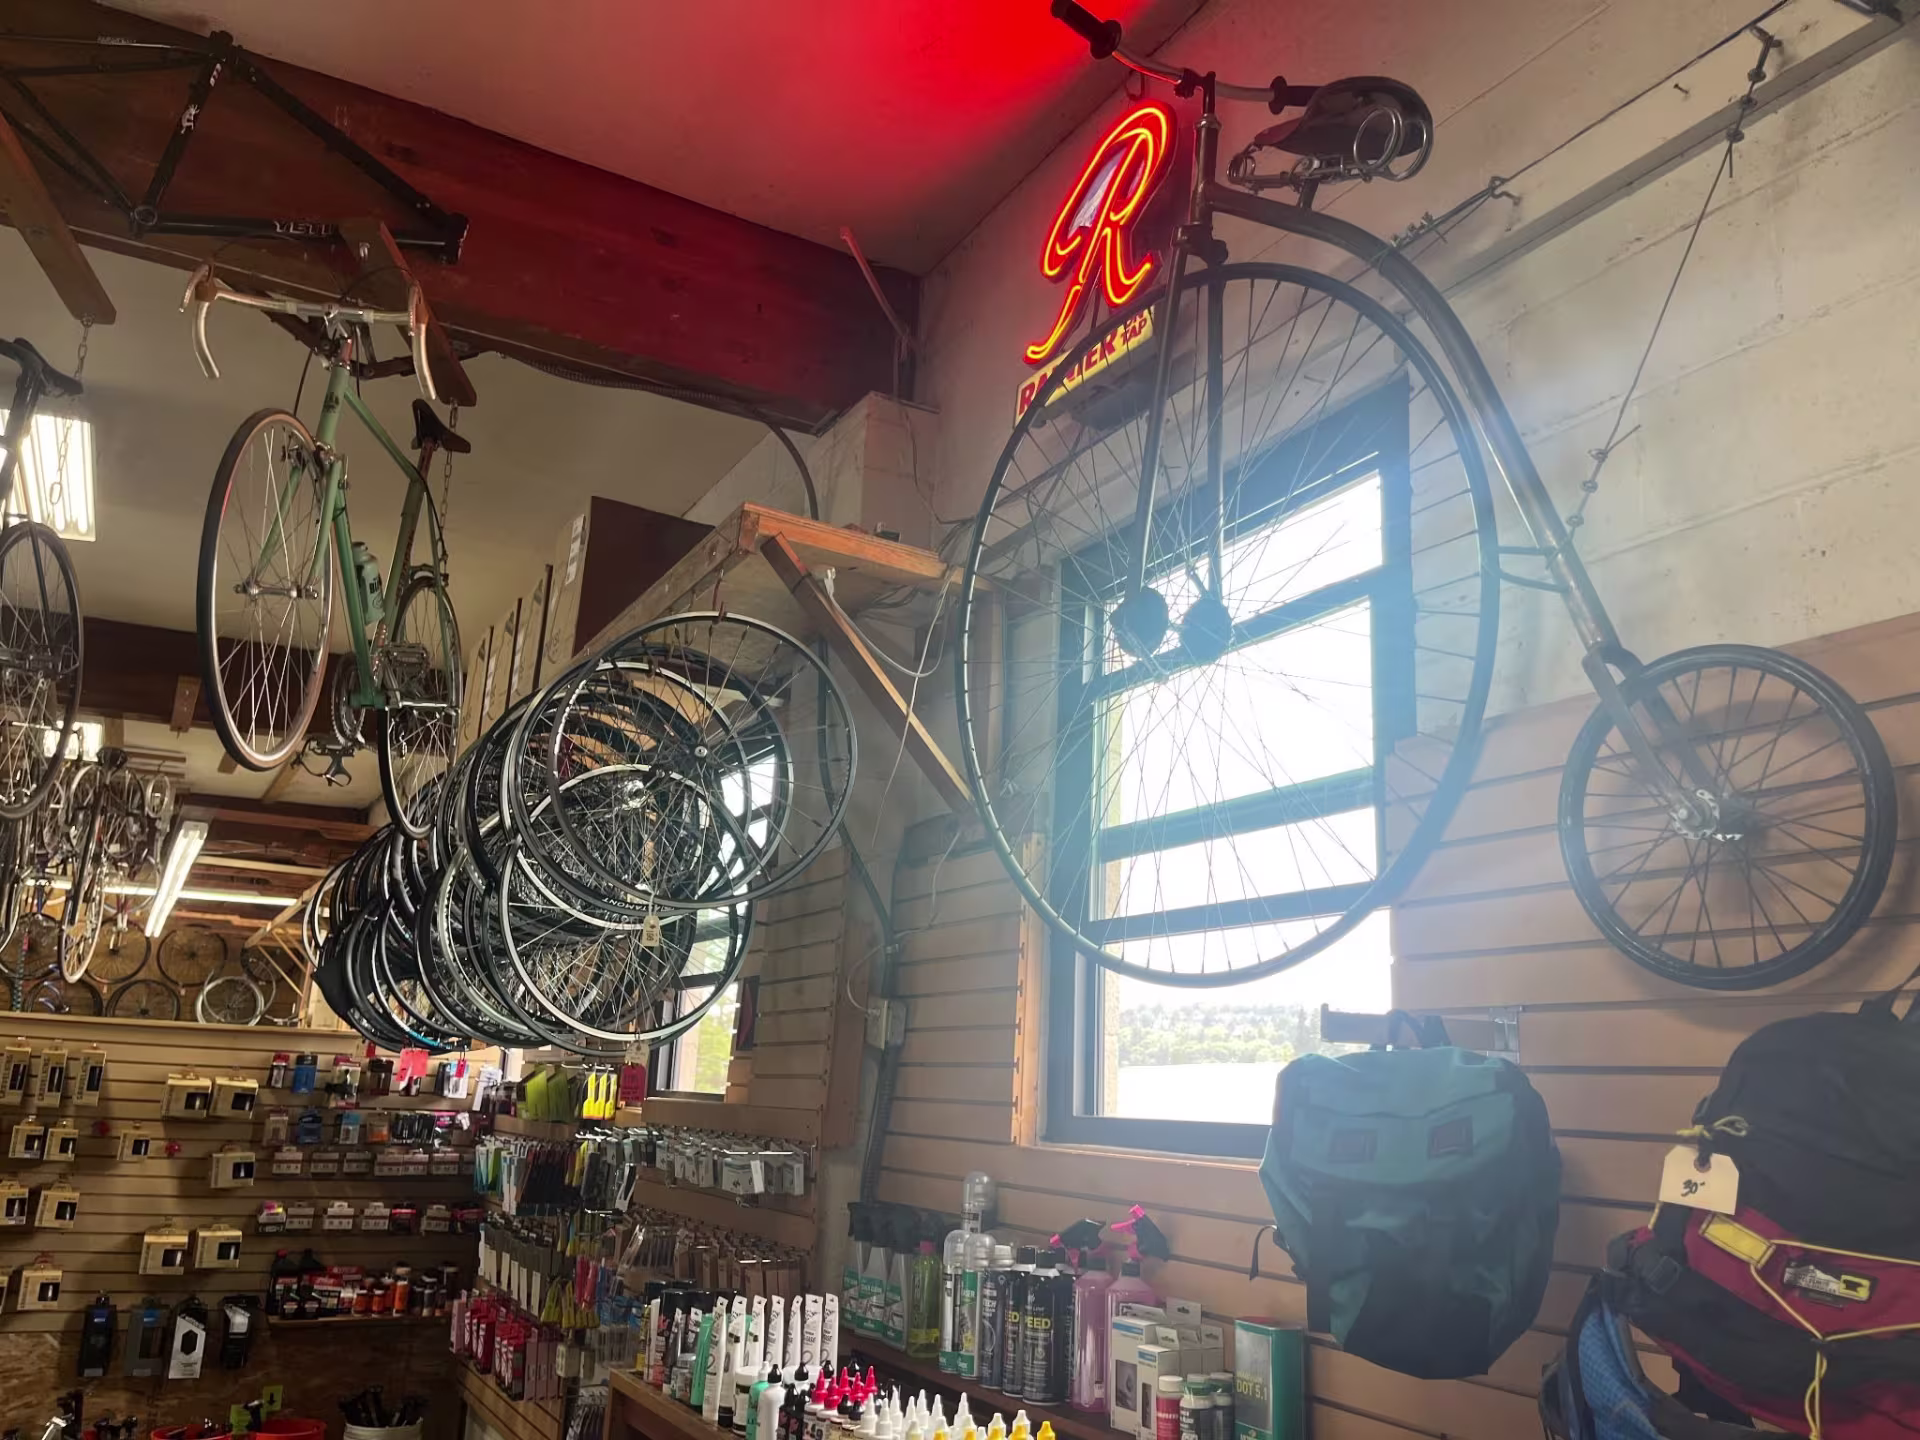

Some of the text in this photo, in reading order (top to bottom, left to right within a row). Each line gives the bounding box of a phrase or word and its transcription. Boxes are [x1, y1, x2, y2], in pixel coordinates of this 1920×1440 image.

[273, 220, 333, 236] YETI
[1023, 100, 1177, 365] R
[1120, 317, 1148, 345] TAP
[1236, 1379, 1268, 1401] DOT 5.1
